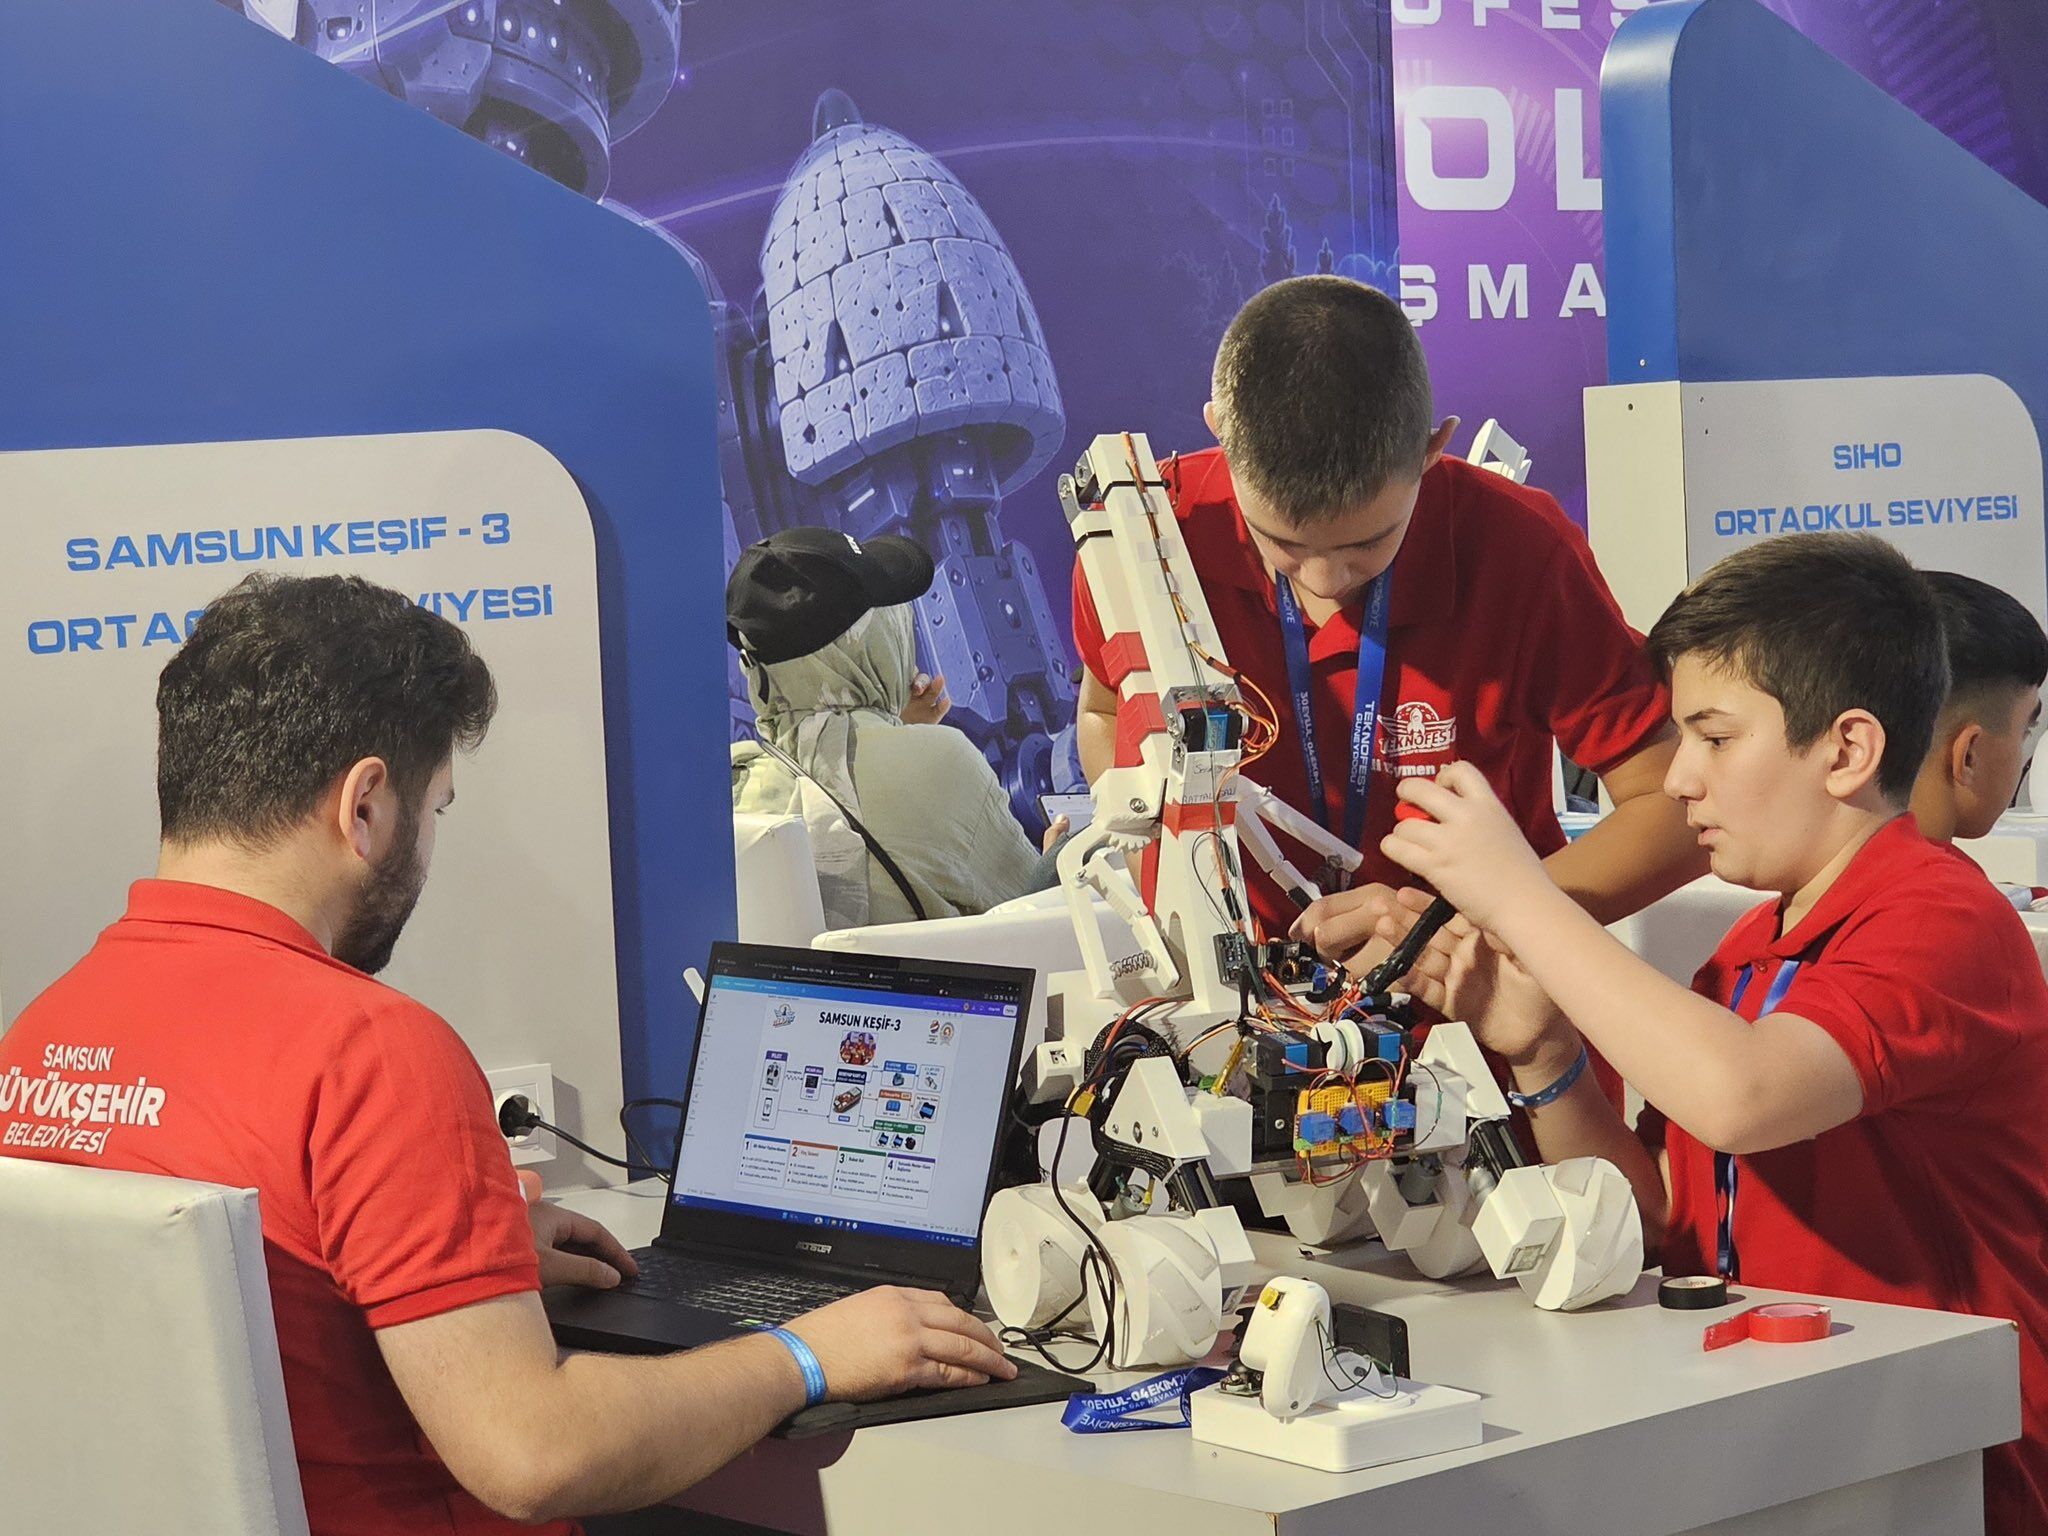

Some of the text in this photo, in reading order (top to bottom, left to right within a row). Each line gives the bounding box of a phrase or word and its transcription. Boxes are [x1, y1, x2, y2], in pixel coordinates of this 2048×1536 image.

[1714, 503, 1882, 536] ORTAOKUL
[66, 525, 303, 571] SAMSUN
[482, 512, 511, 545] 3
[1356, 701, 1376, 796] TEKNOFEST
[819, 1011, 902, 1032] SAMSUN KEŞİF-3
[42, 1043, 115, 1072] SAMSUN
[0, 1066, 166, 1128] ÜYÜKŞEHİR
[791, 1146, 798, 1157] 2
[838, 1153, 845, 1164] 3
[887, 1159, 894, 1170] 4
